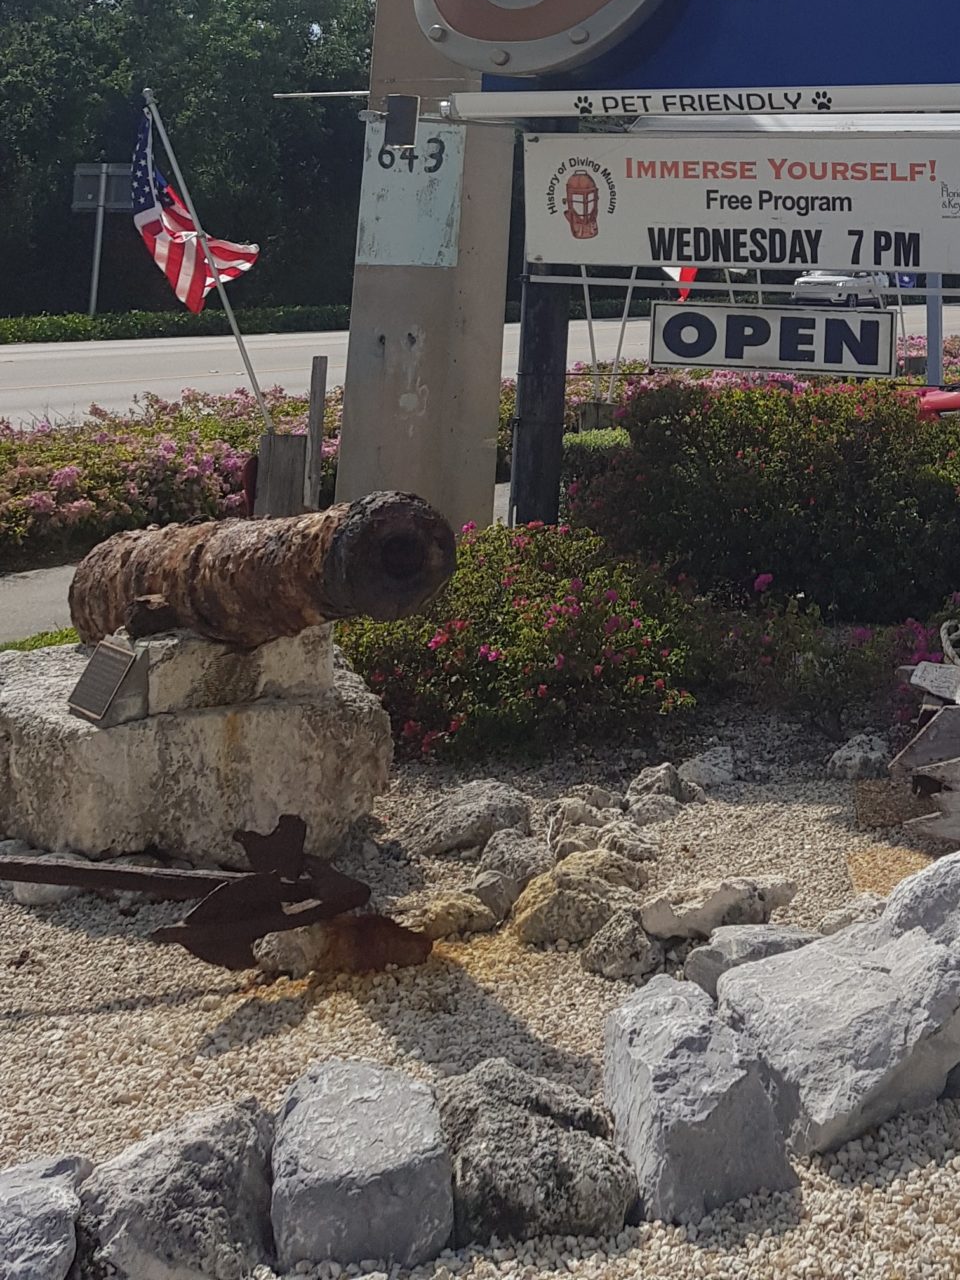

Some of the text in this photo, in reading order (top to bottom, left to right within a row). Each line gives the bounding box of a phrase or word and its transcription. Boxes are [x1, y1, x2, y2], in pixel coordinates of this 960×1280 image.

[601, 92, 802, 113] PET FRIENDLY
[546, 157, 617, 215] History of Diving Museum
[624, 157, 937, 182] IMMERSE YOURSELF!
[705, 189, 852, 217] Free Program
[647, 226, 921, 266] WEDNESDAY 7 PM
[662, 311, 879, 365] OPEN
